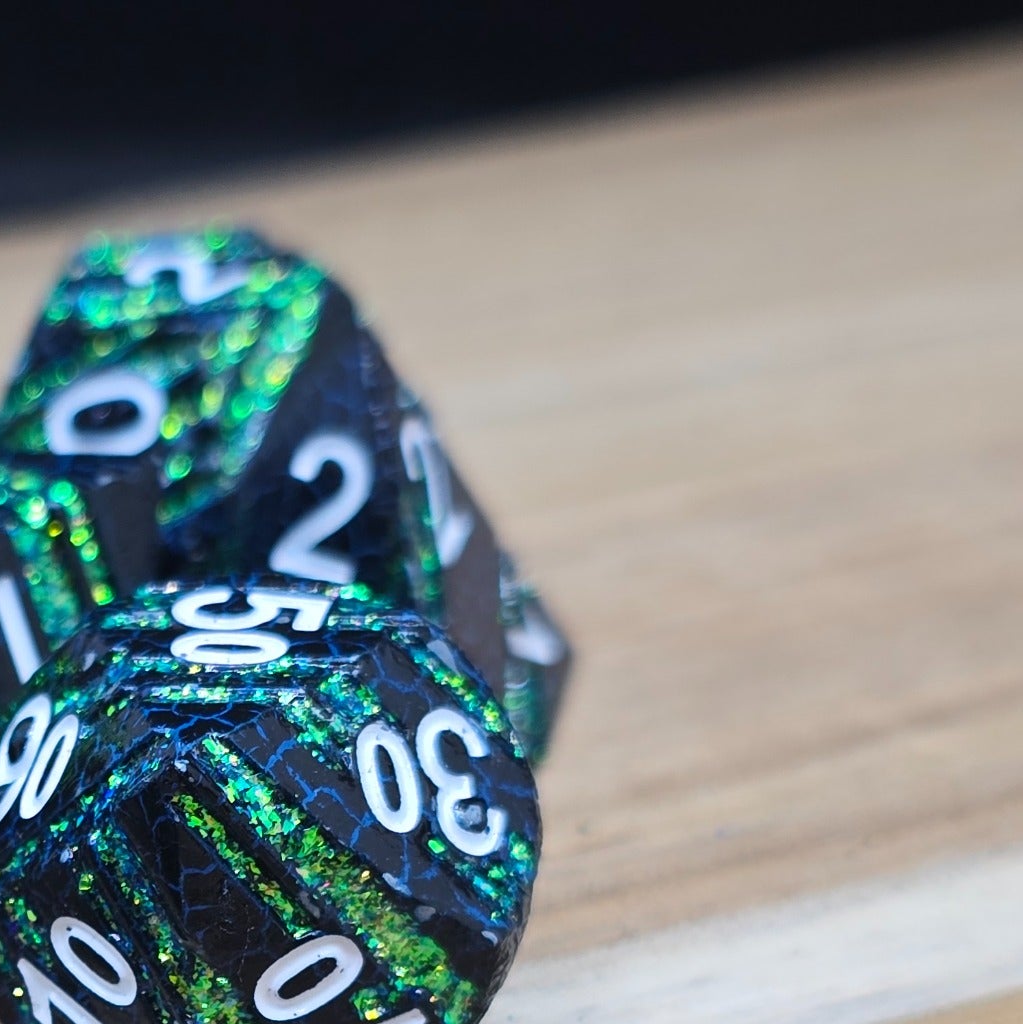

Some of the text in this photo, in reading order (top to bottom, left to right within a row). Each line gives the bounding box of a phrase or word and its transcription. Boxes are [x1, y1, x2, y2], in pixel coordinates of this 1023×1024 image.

[270, 434, 376, 585] 2
[169, 585, 333, 665] 50
[355, 707, 510, 856] 30
